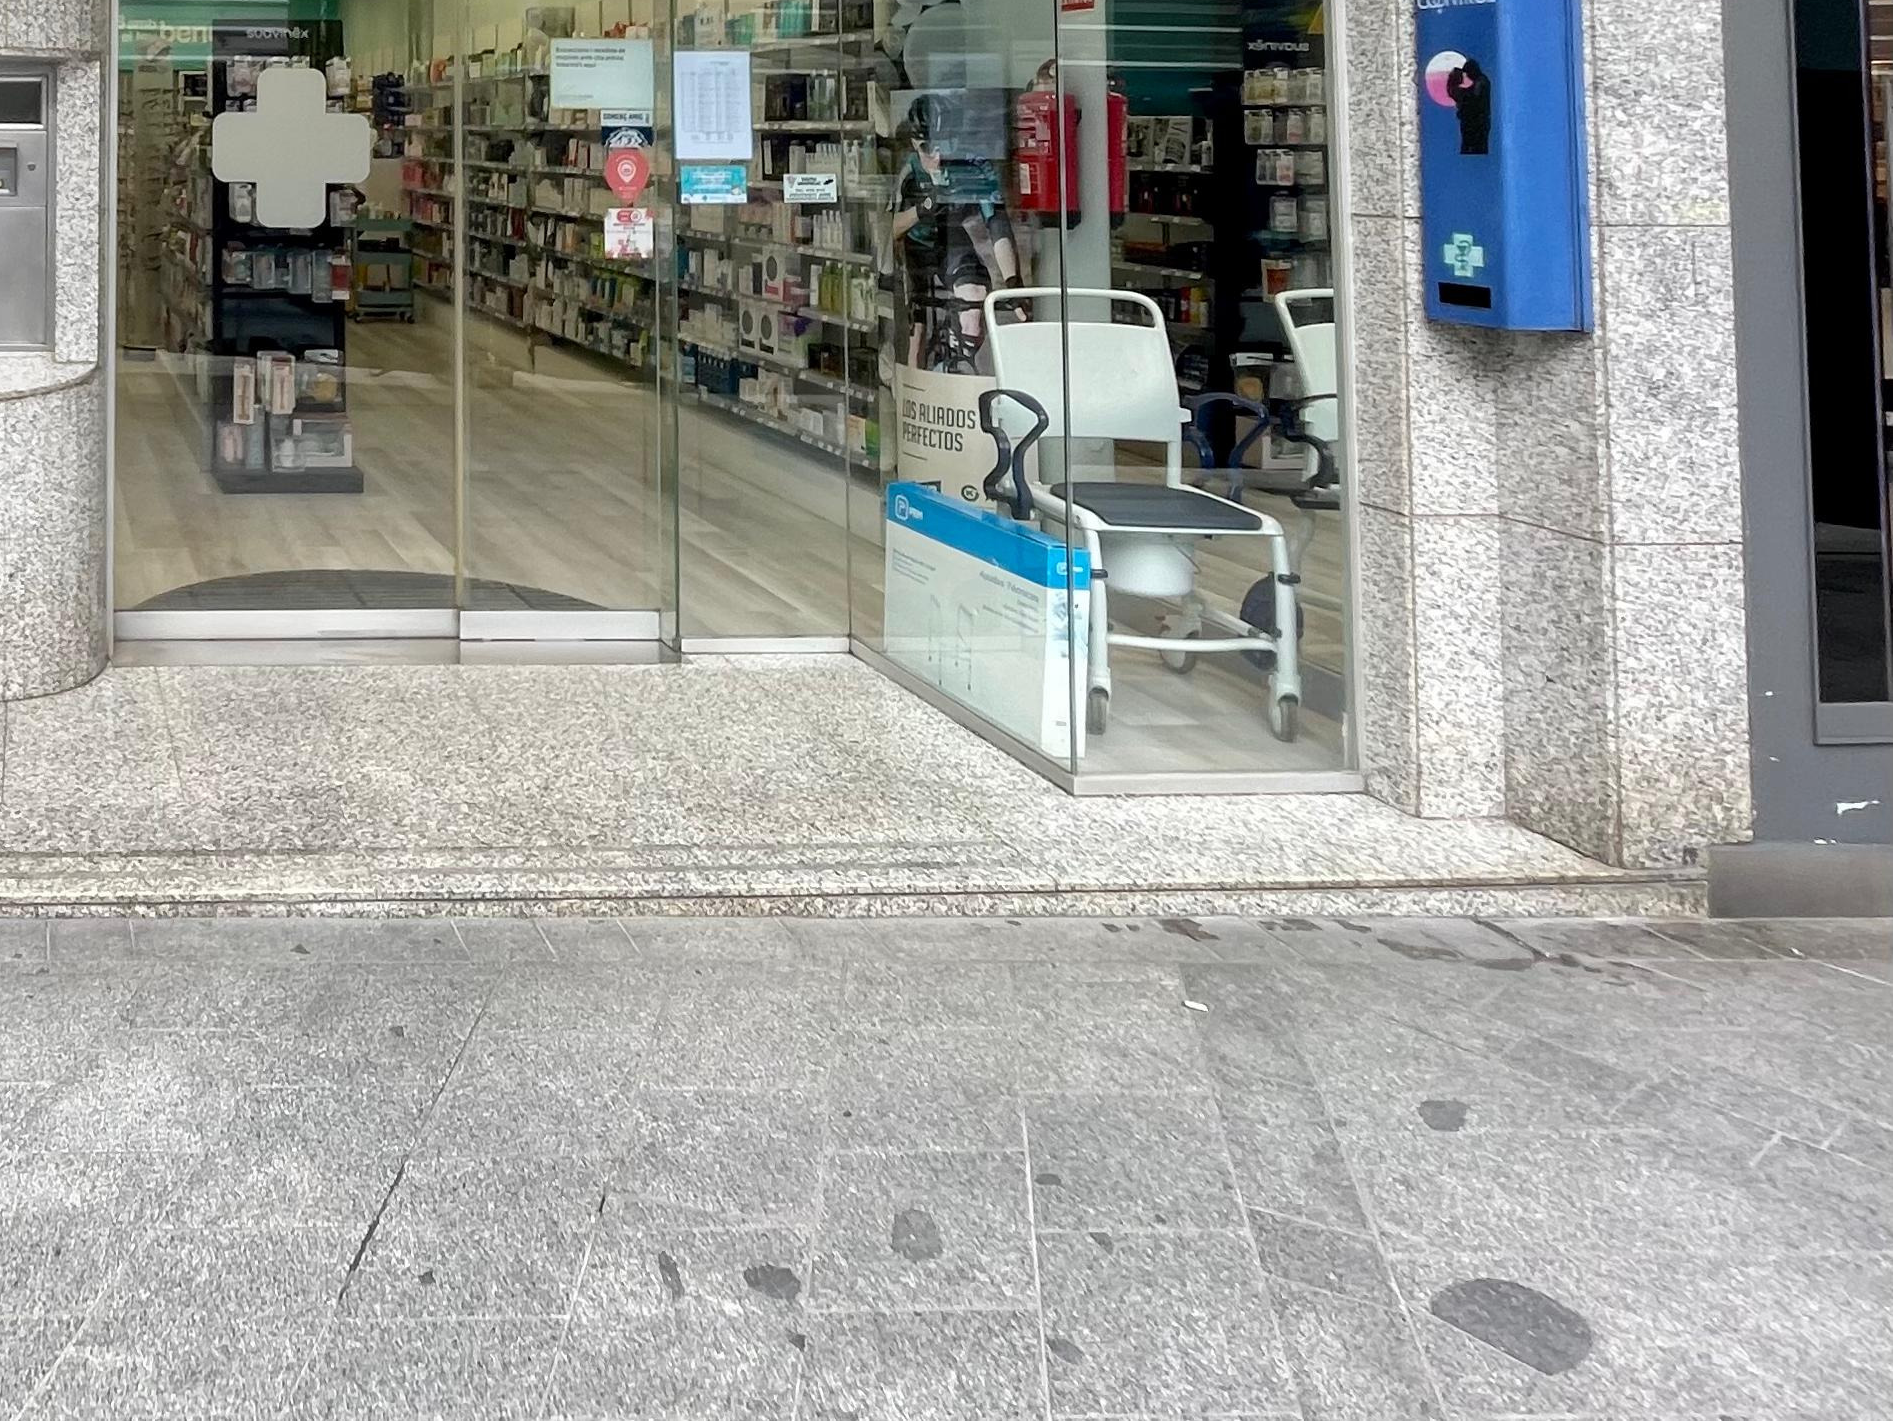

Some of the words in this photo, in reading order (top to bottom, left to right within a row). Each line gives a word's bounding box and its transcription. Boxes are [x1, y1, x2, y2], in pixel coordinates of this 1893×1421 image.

[902, 397, 917, 420] LOS
[919, 403, 976, 430] ALIADOS
[902, 421, 964, 452] PERFECTOS
